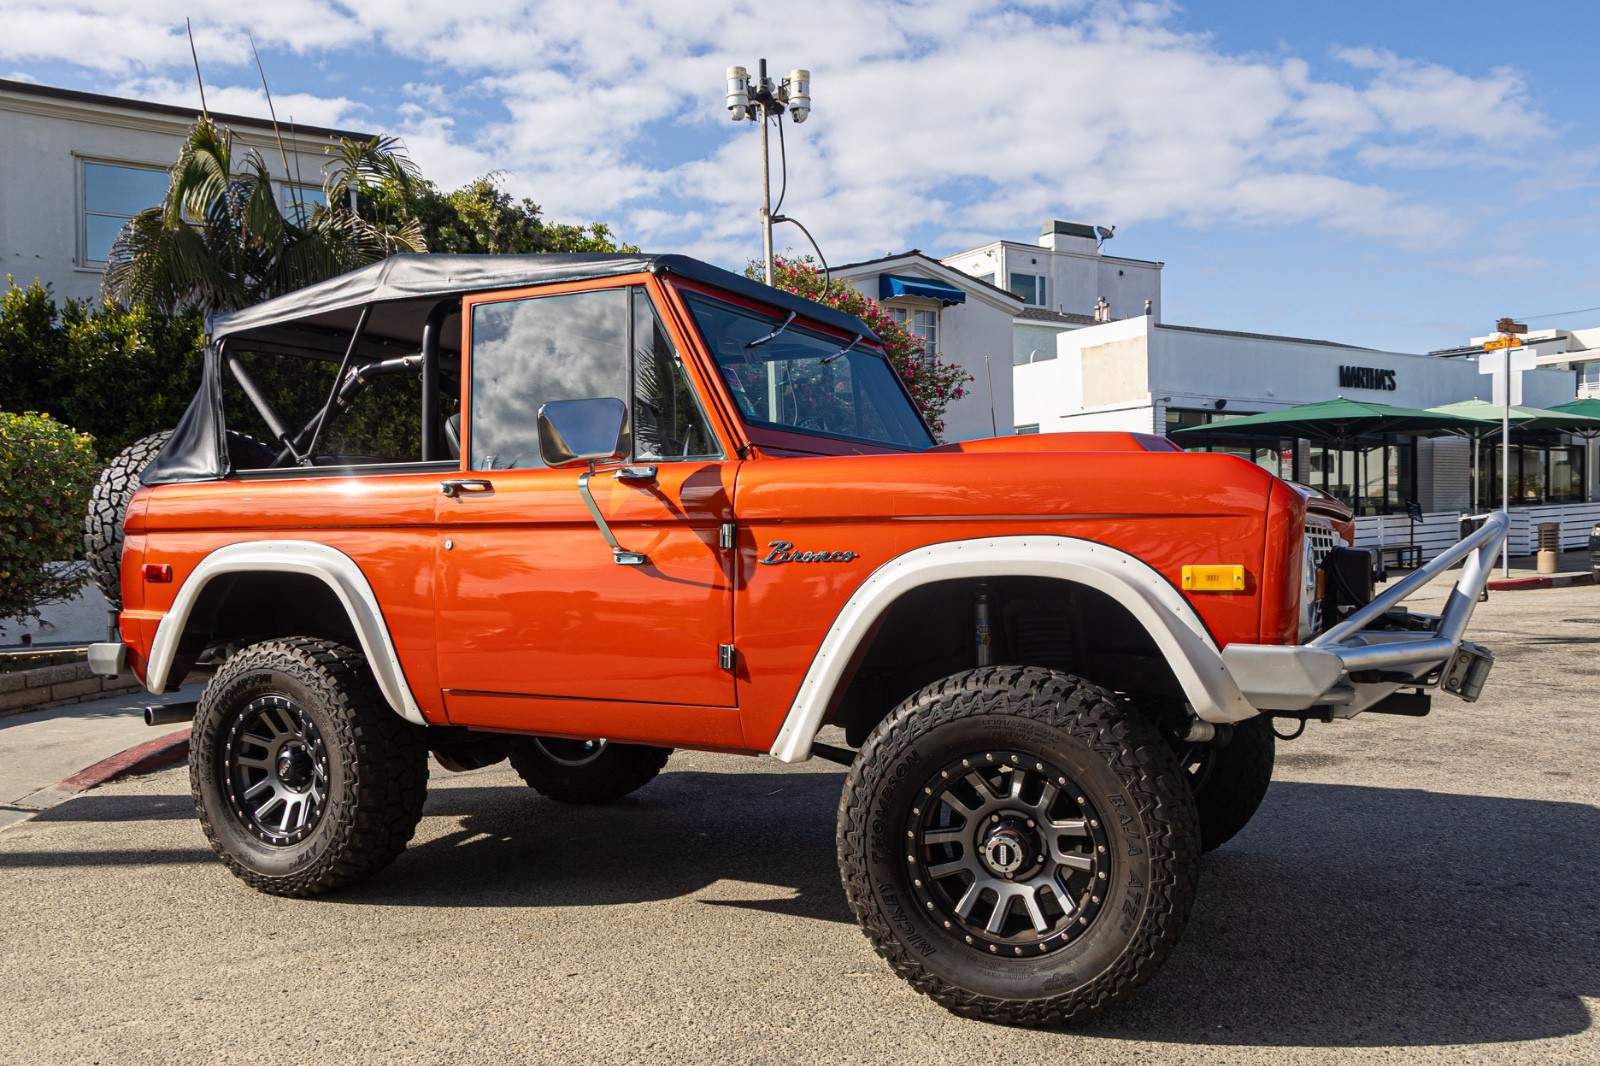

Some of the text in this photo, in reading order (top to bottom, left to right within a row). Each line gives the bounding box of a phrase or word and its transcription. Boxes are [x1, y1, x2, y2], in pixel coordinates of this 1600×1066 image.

[1338, 365, 1397, 391] MARTHA'S
[757, 540, 860, 566] Bronco
[213, 673, 273, 715] THOMPSON
[1107, 793, 1143, 857] BAJA
[870, 748, 937, 957] MICKEY THOMPSON
